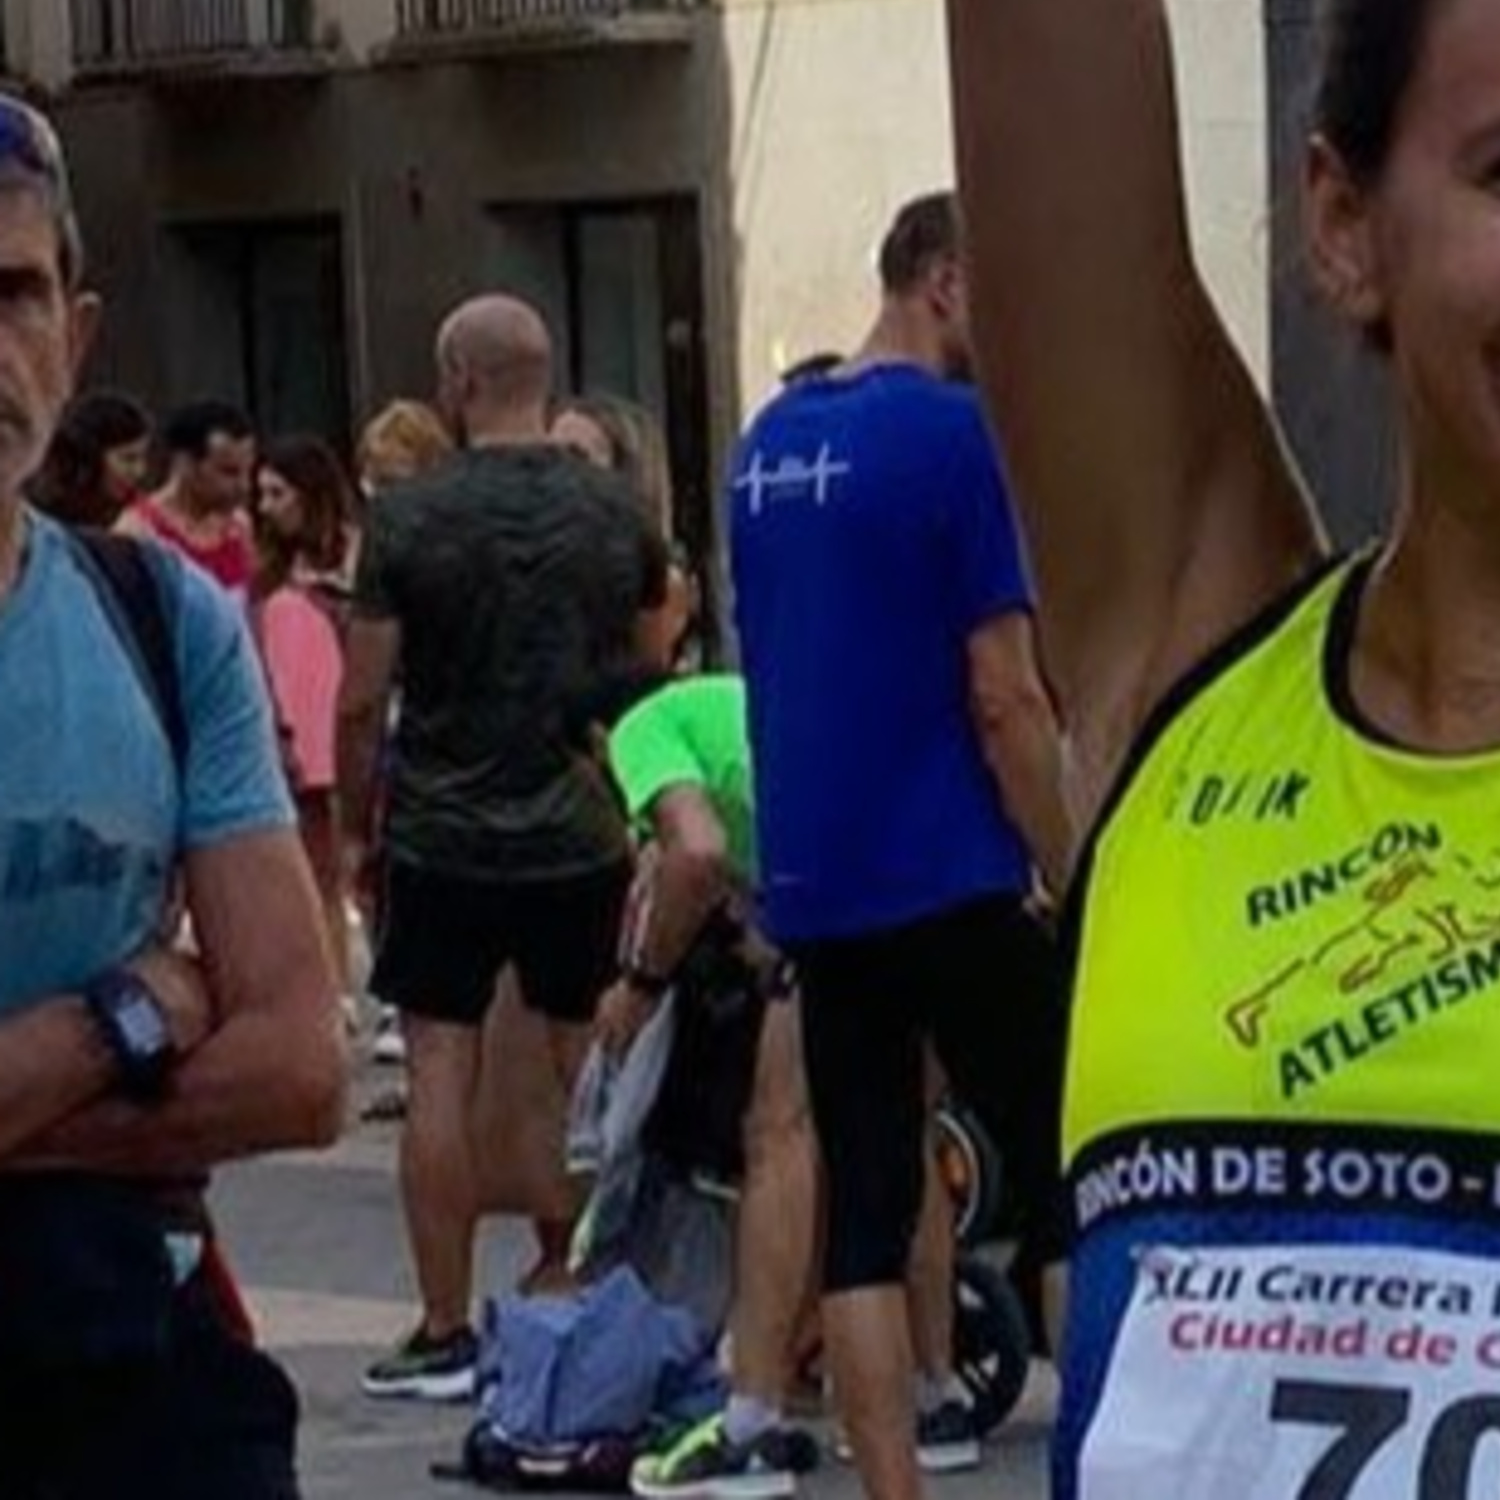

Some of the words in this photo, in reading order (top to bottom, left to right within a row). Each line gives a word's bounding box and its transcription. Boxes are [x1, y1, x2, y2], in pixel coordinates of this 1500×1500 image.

[1212, 1147, 1286, 1194] DE
[1304, 1148, 1451, 1200] SOTO
[1257, 1264, 1472, 1316] Carrera
[1169, 1311, 1367, 1357] Ciudad
[1386, 1323, 1457, 1366] de
